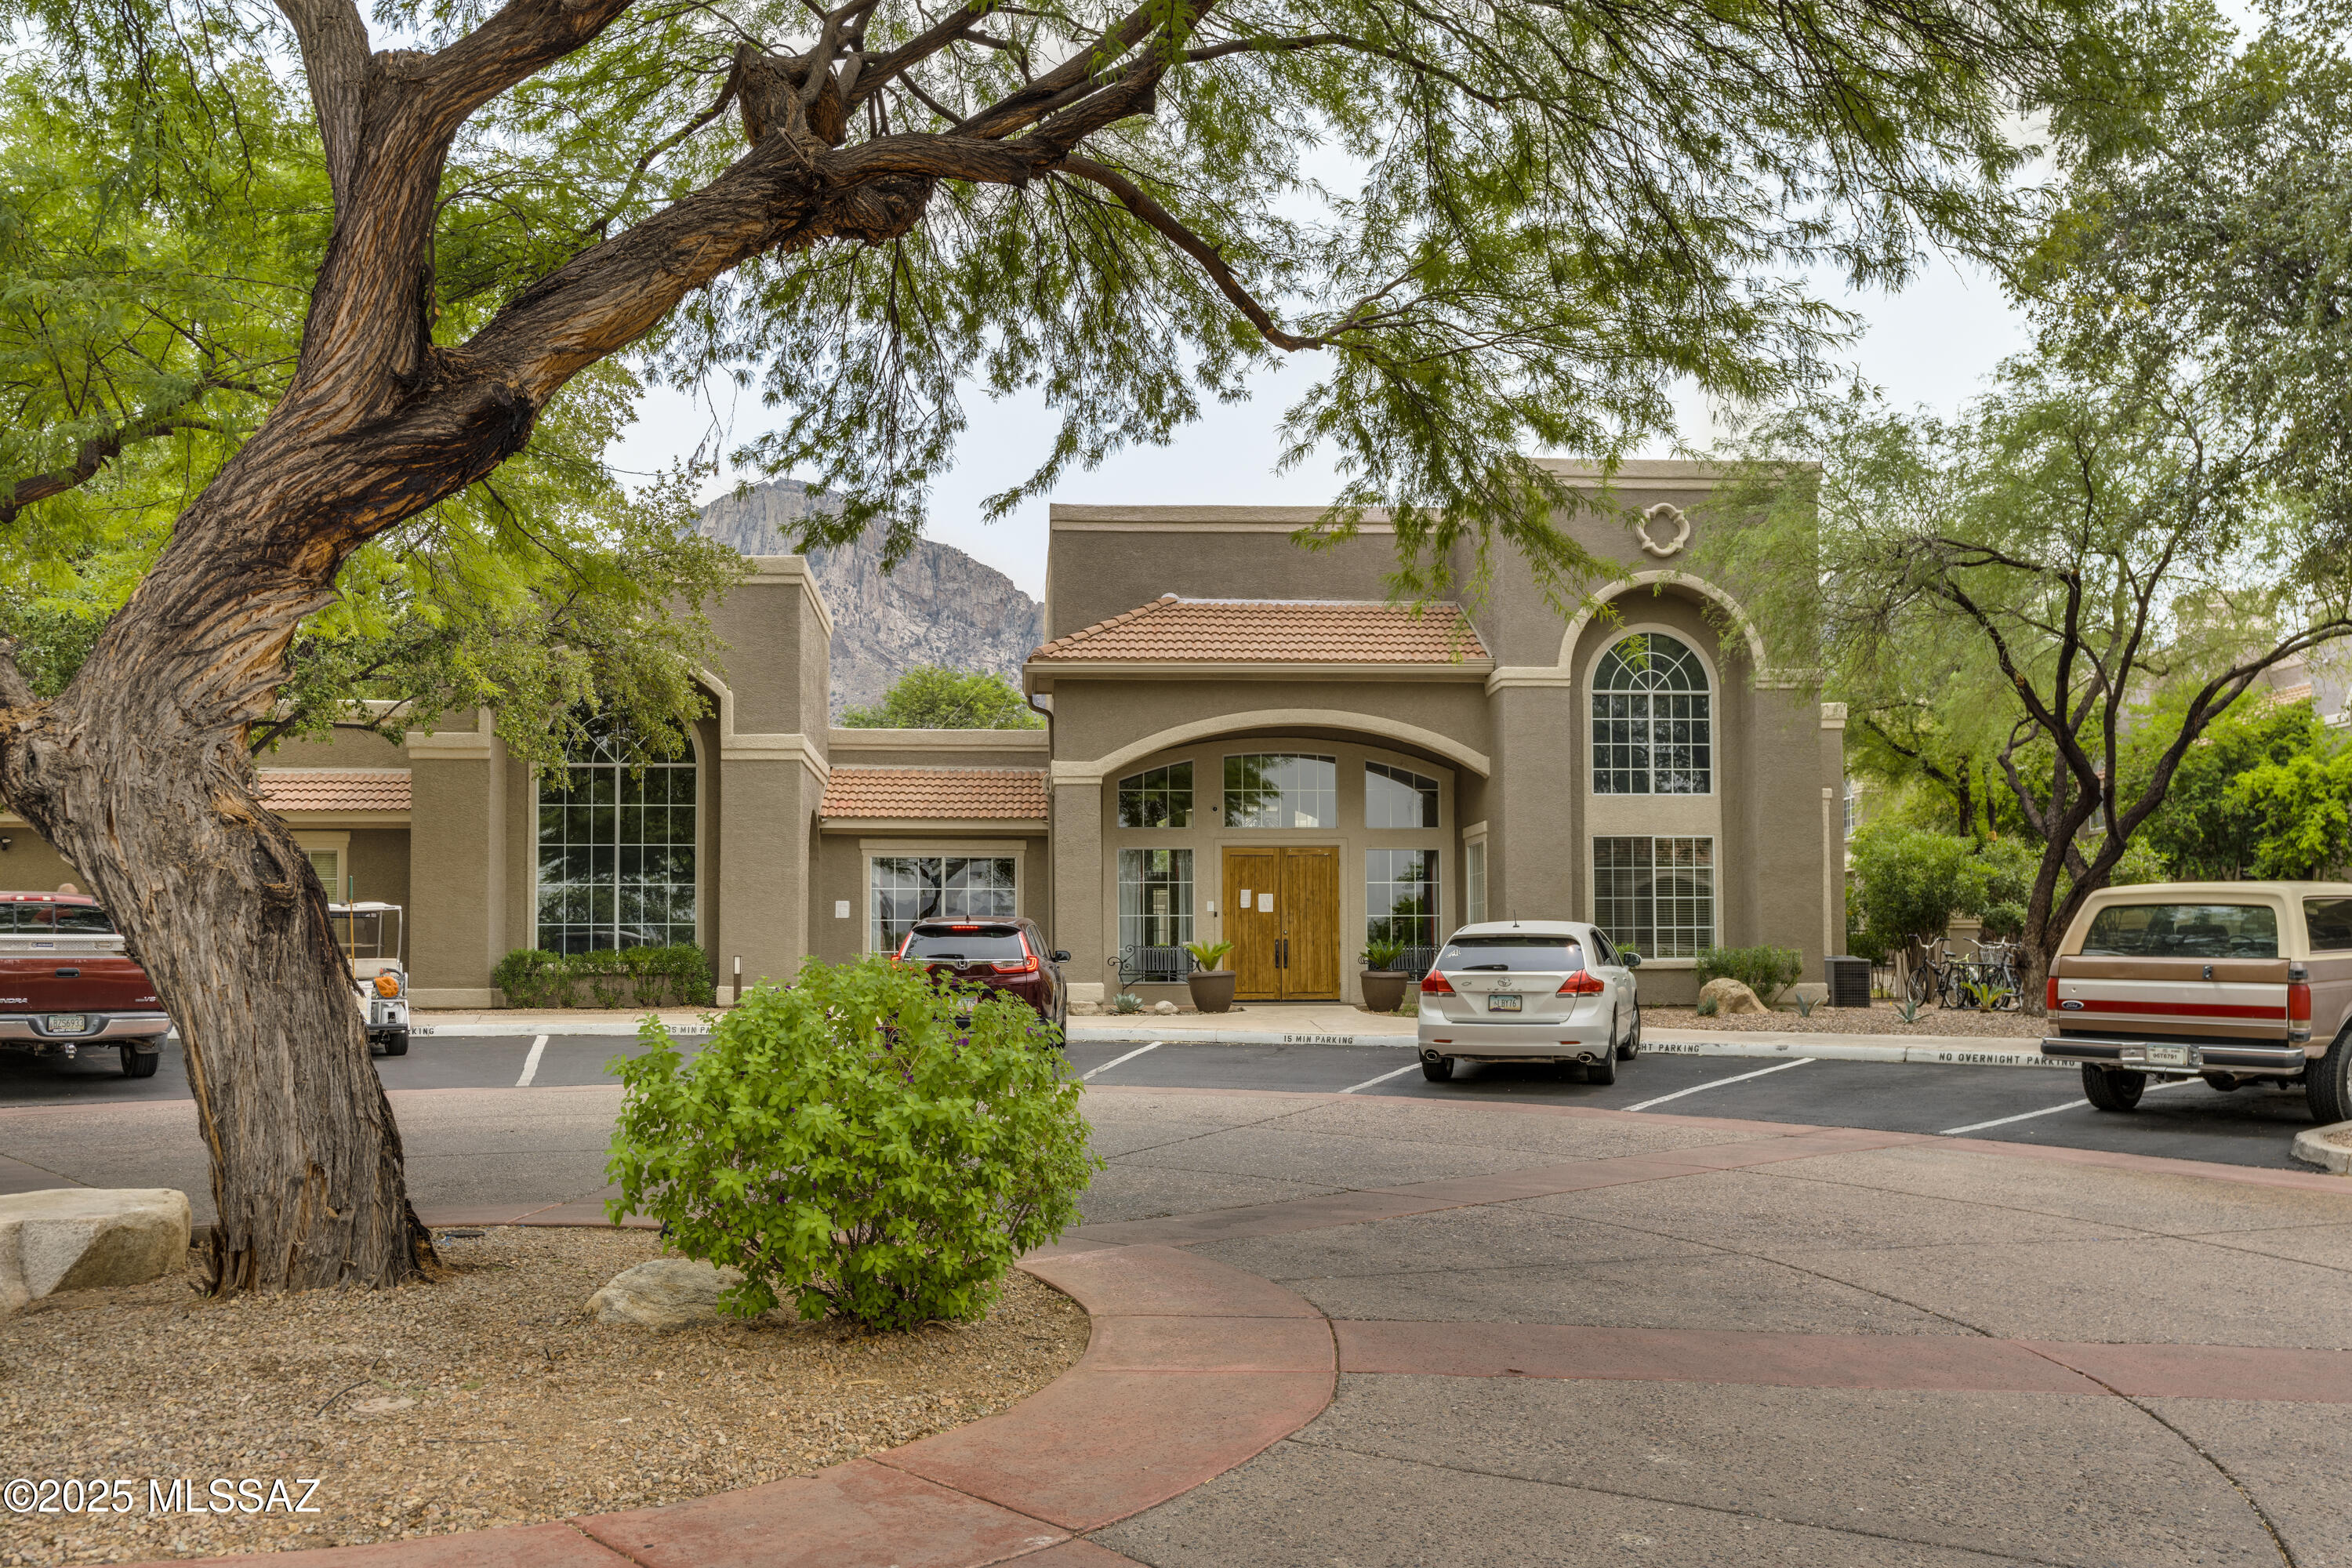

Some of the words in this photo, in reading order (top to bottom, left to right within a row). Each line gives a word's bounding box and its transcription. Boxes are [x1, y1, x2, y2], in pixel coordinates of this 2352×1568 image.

[53, 1018, 84, 1028] BZS6933
[1315, 1036, 1353, 1044] PARKING
[1658, 1044, 1700, 1053] PARKING
[1939, 1052, 1952, 1062] NO
[1958, 1053, 2020, 1065] OVERNIGHT
